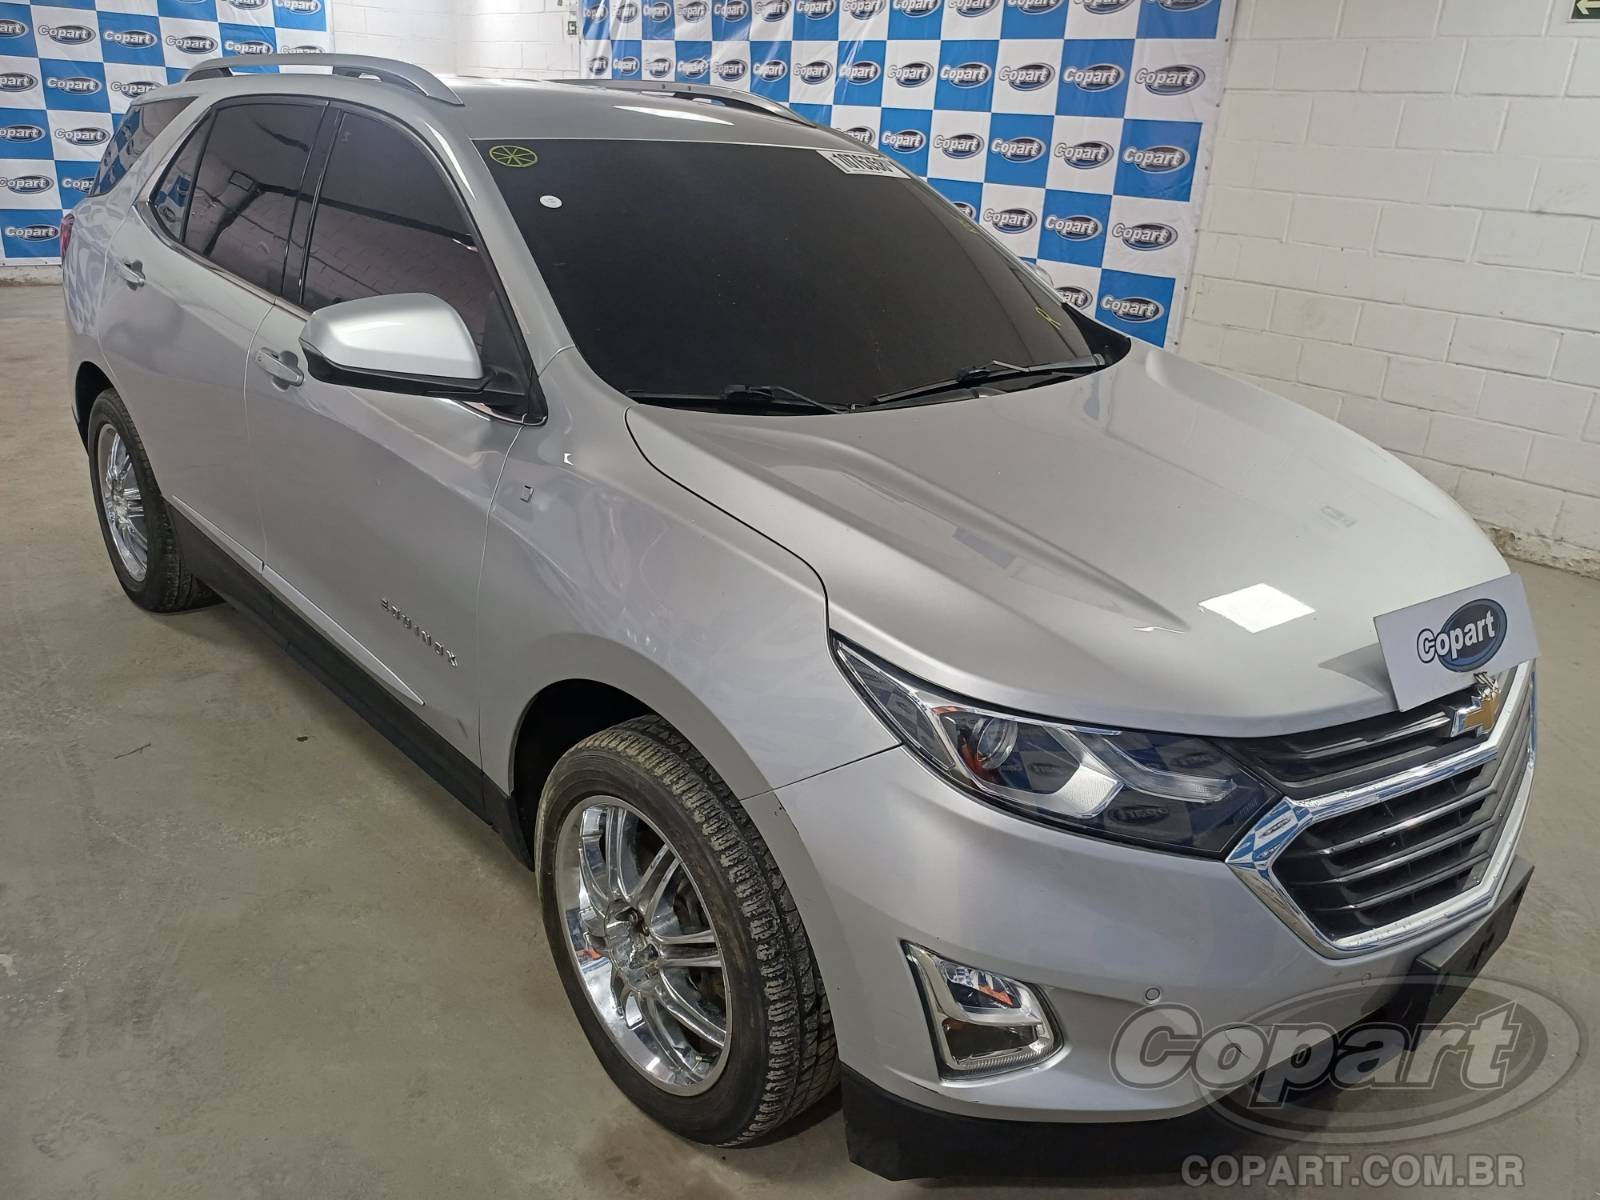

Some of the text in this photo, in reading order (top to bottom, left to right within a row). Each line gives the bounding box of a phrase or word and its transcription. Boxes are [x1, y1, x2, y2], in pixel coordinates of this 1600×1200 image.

[796, 0, 831, 13] Copart
[0, 23, 21, 33] art
[38, 25, 88, 40] Copart
[104, 30, 151, 44] Copart
[167, 36, 212, 49] Copart
[224, 41, 268, 54] Copart
[793, 63, 827, 79] Copart
[888, 65, 928, 82] Copart
[940, 64, 985, 82] Copart
[1000, 66, 1048, 84] Copart
[1064, 67, 1116, 88] Copart
[1135, 68, 1195, 89] Copart
[0, 75, 29, 88] part
[48, 78, 96, 91] Copart
[111, 82, 156, 94] Copar
[0, 127, 39, 140] opart
[55, 129, 104, 141] Copart
[881, 131, 921, 148] Copart
[934, 135, 979, 153] Copart
[992, 138, 1039, 157] Copart
[1054, 143, 1106, 162] Copart
[1124, 147, 1183, 168] Copart
[62, 178, 92, 190] Cop
[983, 208, 1030, 226] Copart
[1045, 214, 1095, 237] Copart
[5, 226, 55, 237] Copart
[1112, 223, 1170, 244] Copart
[1102, 297, 1154, 318] Copart
[1416, 610, 1496, 664] Copart
